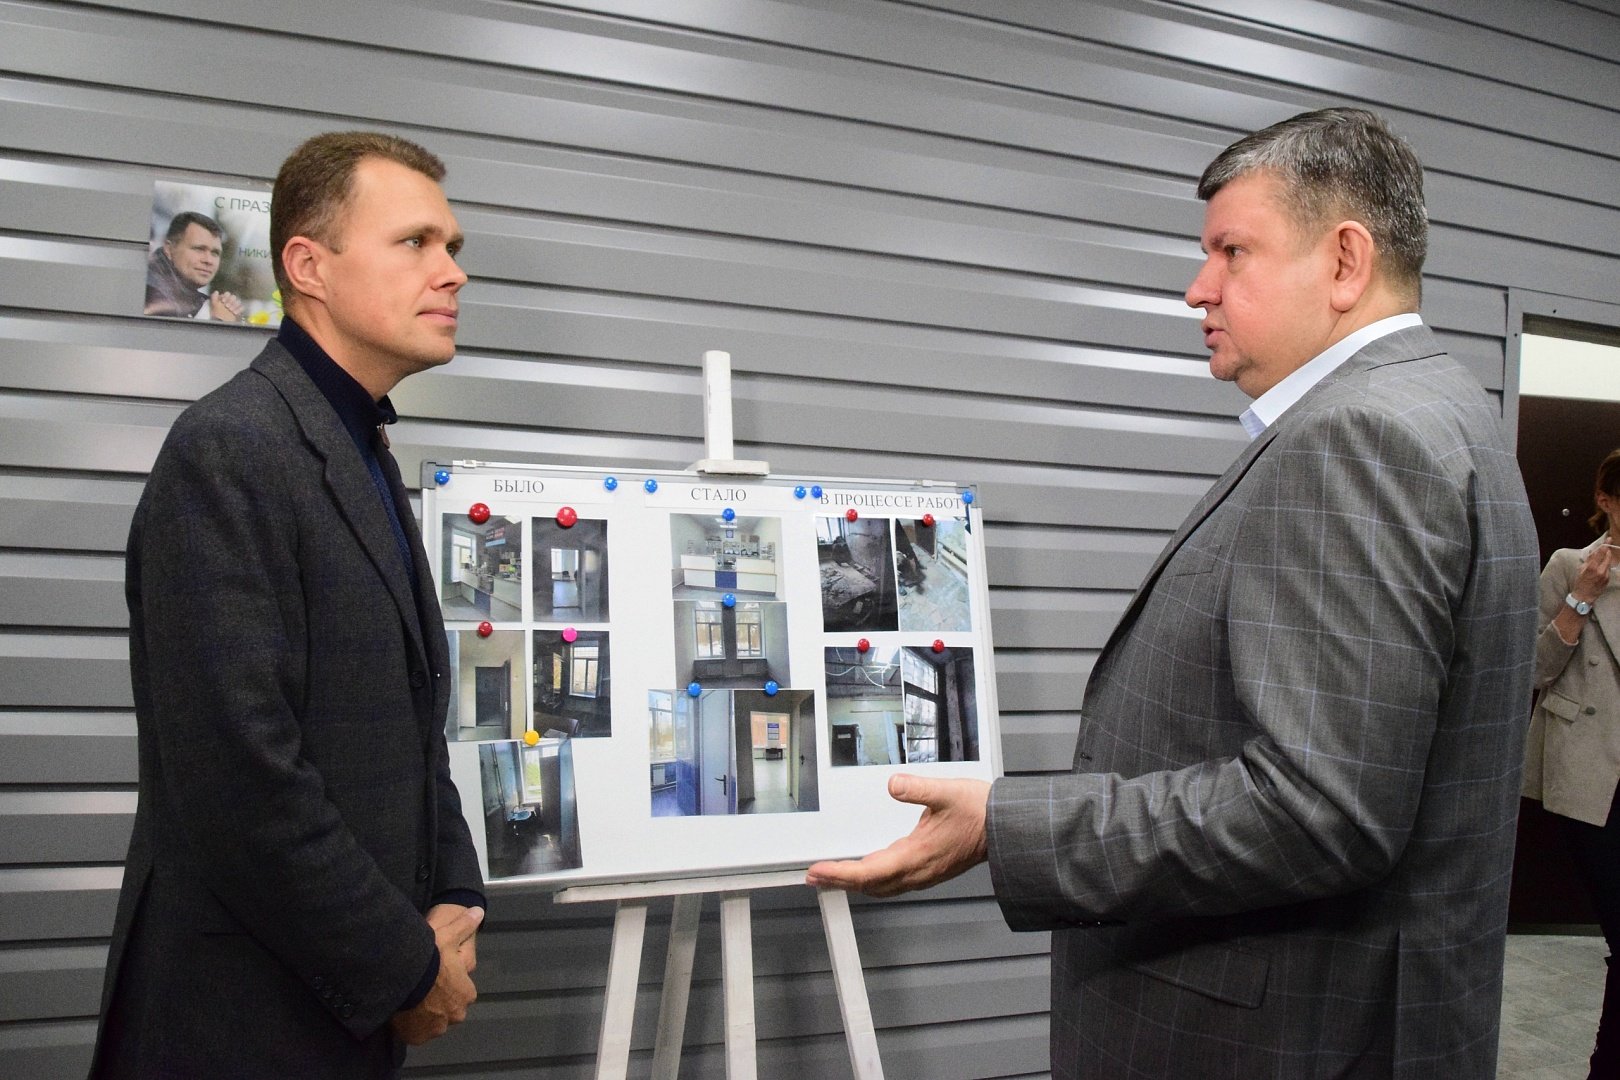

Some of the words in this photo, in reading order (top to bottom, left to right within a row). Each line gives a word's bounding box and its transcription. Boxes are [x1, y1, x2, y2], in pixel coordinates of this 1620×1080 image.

[214, 196, 225, 209] С
[493, 479, 545, 494] БЫЛО
[690, 487, 747, 502] СТАЛО
[820, 493, 829, 505] В
[834, 493, 913, 509] ПРОЦЕССЕ
[917, 497, 962, 509] РАБОТ
